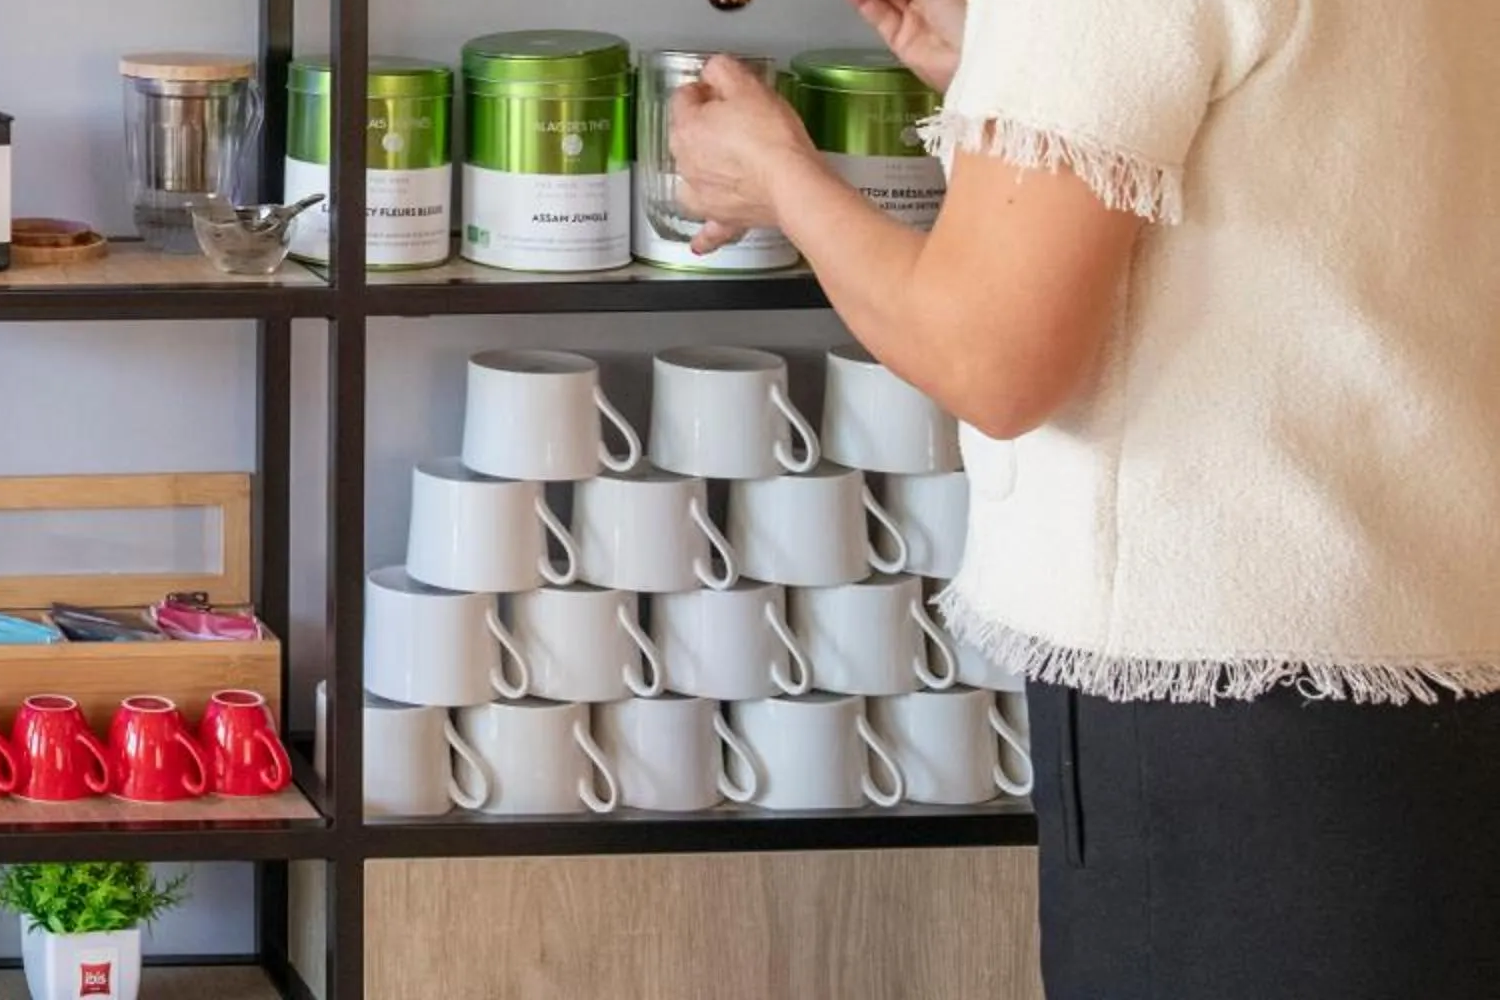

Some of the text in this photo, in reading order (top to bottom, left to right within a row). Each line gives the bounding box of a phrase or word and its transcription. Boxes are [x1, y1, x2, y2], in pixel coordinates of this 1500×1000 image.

[532, 210, 608, 223] ASSAM JUNGLE
[85, 971, 107, 985] ibis
